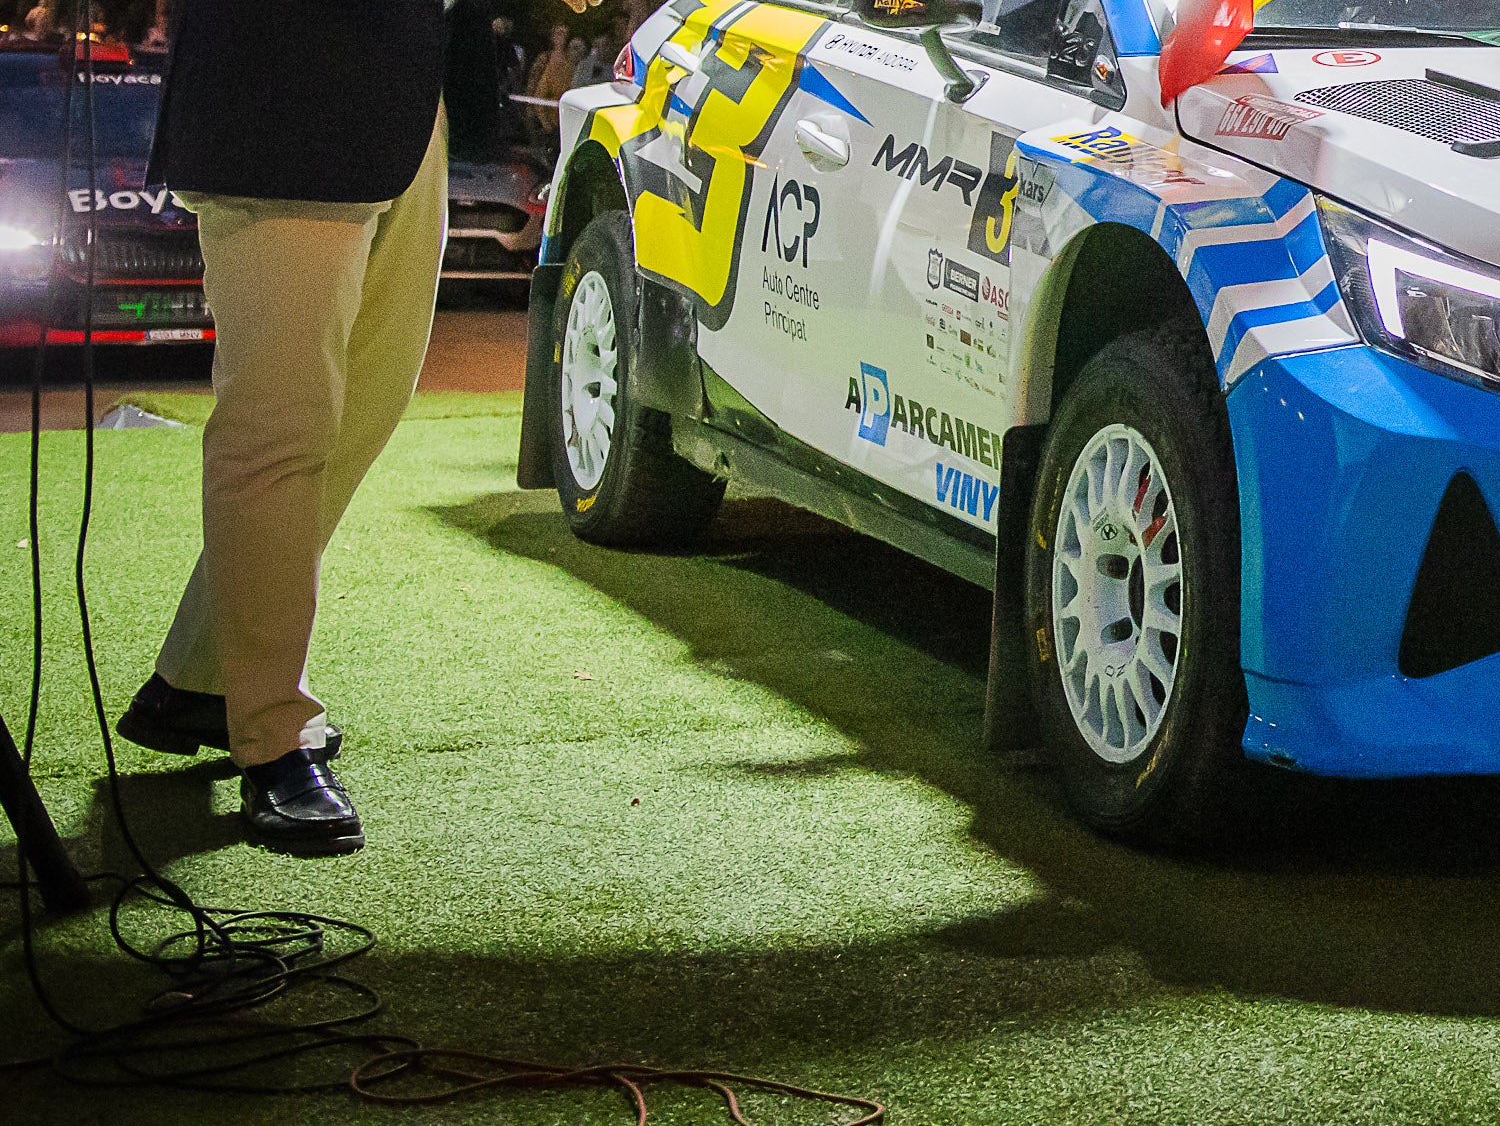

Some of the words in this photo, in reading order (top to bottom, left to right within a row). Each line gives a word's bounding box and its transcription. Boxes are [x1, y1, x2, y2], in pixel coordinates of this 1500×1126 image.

[1332, 52, 1367, 65] E
[871, 134, 983, 207] MMR
[68, 188, 186, 215] Boy
[985, 151, 1019, 254] 3
[762, 265, 785, 296] Auto
[784, 276, 821, 311] Centre
[763, 300, 808, 342] Principat
[845, 362, 1001, 471] APARCAMEN
[935, 462, 999, 522] VINY
